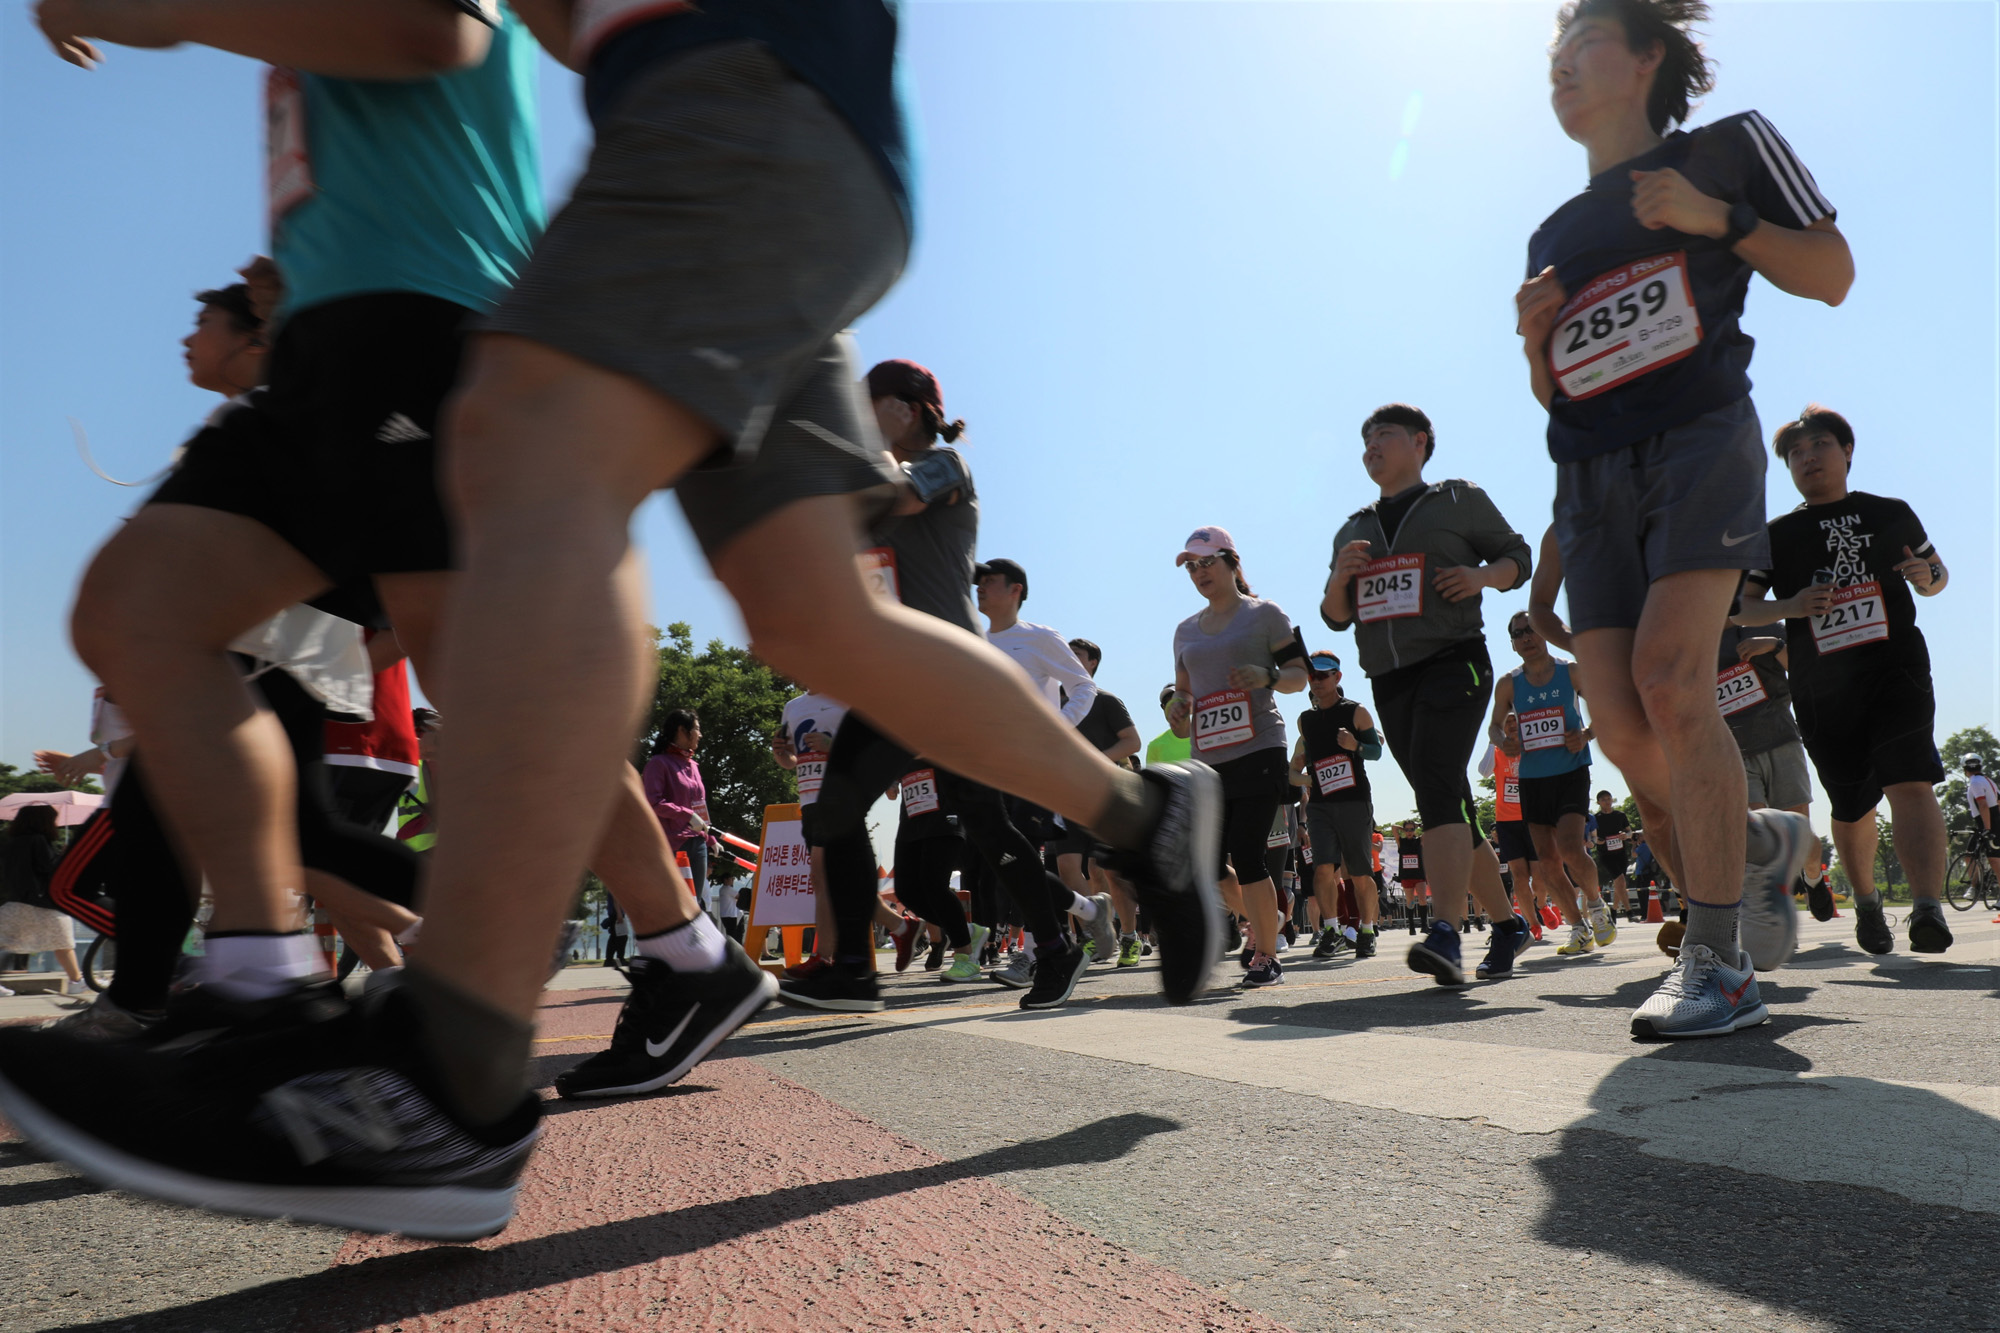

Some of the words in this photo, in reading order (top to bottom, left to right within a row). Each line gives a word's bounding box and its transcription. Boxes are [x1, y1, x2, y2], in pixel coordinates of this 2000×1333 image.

[1631, 255, 1675, 275] Run
[1564, 279, 1667, 354] 2859
[1819, 513, 1862, 530] RUN
[1829, 525, 1854, 539] AS
[1826, 533, 1874, 552] FAST
[1397, 556, 1419, 566] Run
[1838, 549, 1860, 563] AS
[1363, 573, 1413, 598] 2045
[1854, 585, 1876, 597] Run
[1820, 600, 1875, 631] 2217
[1734, 663, 1750, 673] Run
[1225, 691, 1245, 700] Run
[1717, 675, 1754, 701] 2123
[1200, 705, 1242, 730] 2750
[1520, 710, 1546, 721] Burning
[1546, 707, 1561, 716] Run
[1524, 719, 1559, 737] 2109
[1319, 763, 1347, 782] 3027
[904, 782, 930, 801] 2215
[1507, 785, 1519, 794] 25
[764, 845, 790, 867] 마라톤
